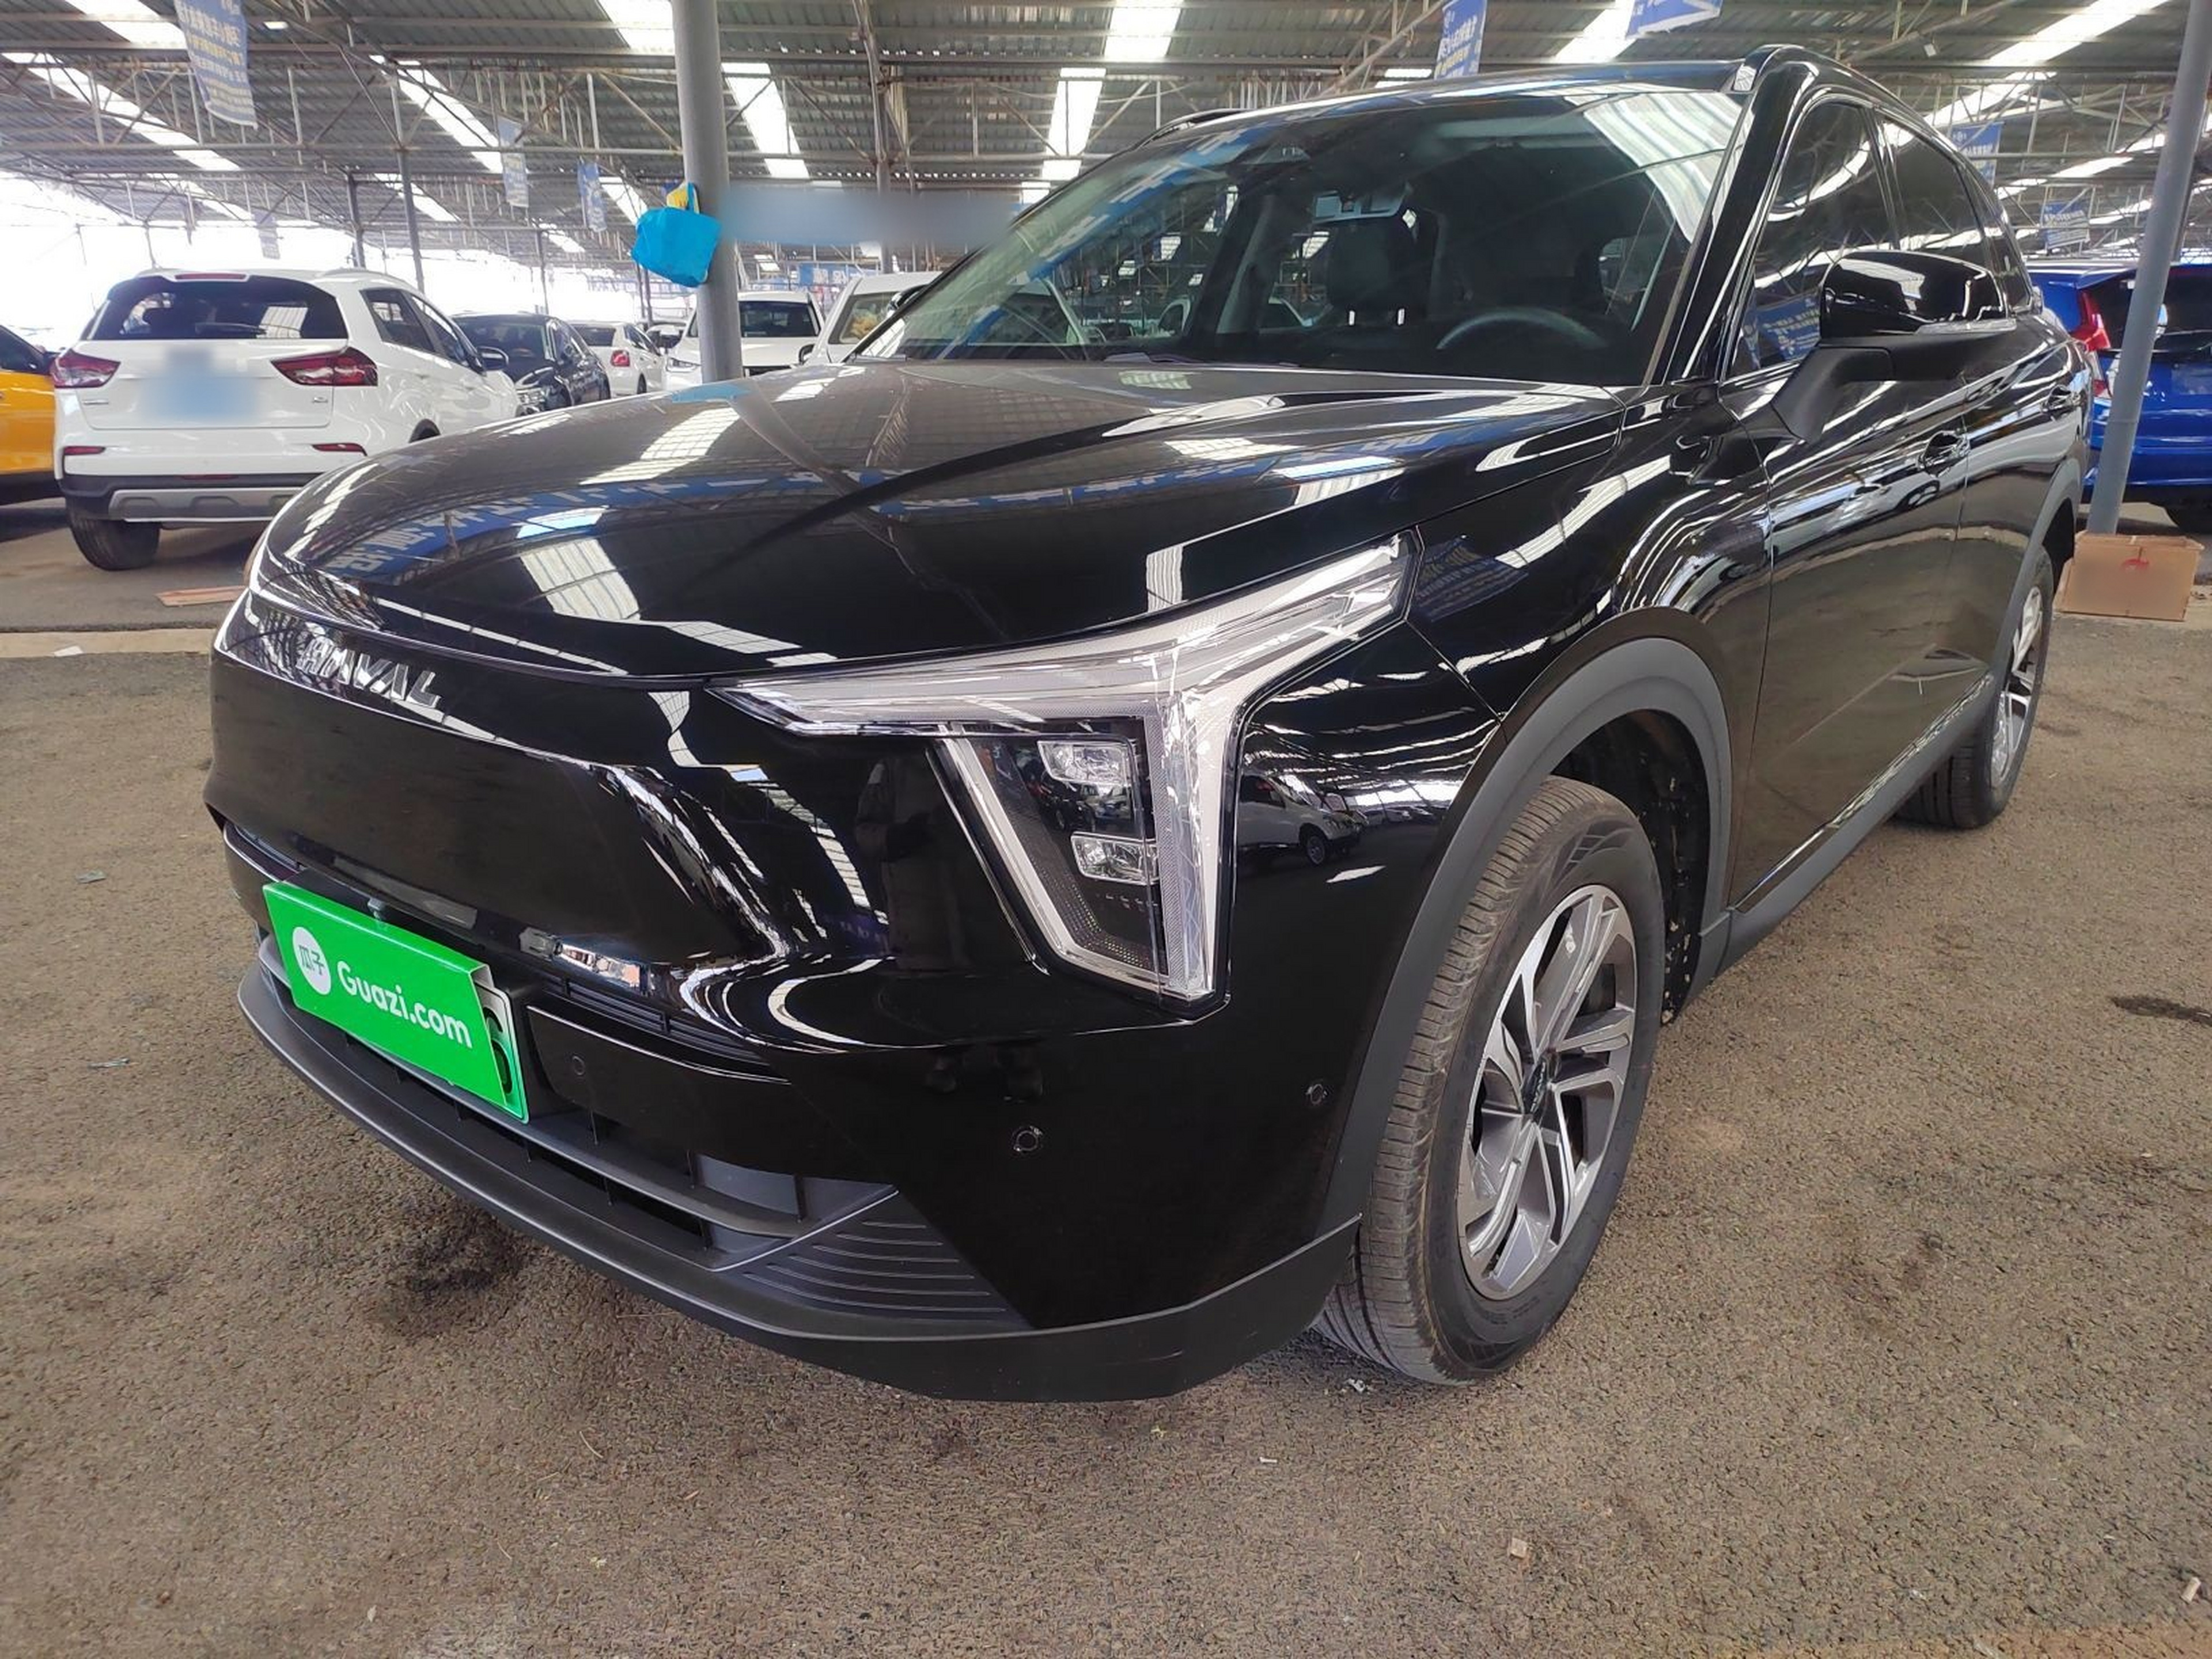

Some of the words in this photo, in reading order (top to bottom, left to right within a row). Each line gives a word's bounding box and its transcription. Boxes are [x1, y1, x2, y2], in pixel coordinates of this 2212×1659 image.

[296, 635, 441, 708] HAVAL
[298, 945, 324, 976] 瓜子
[337, 960, 473, 1048] Guazi.com
